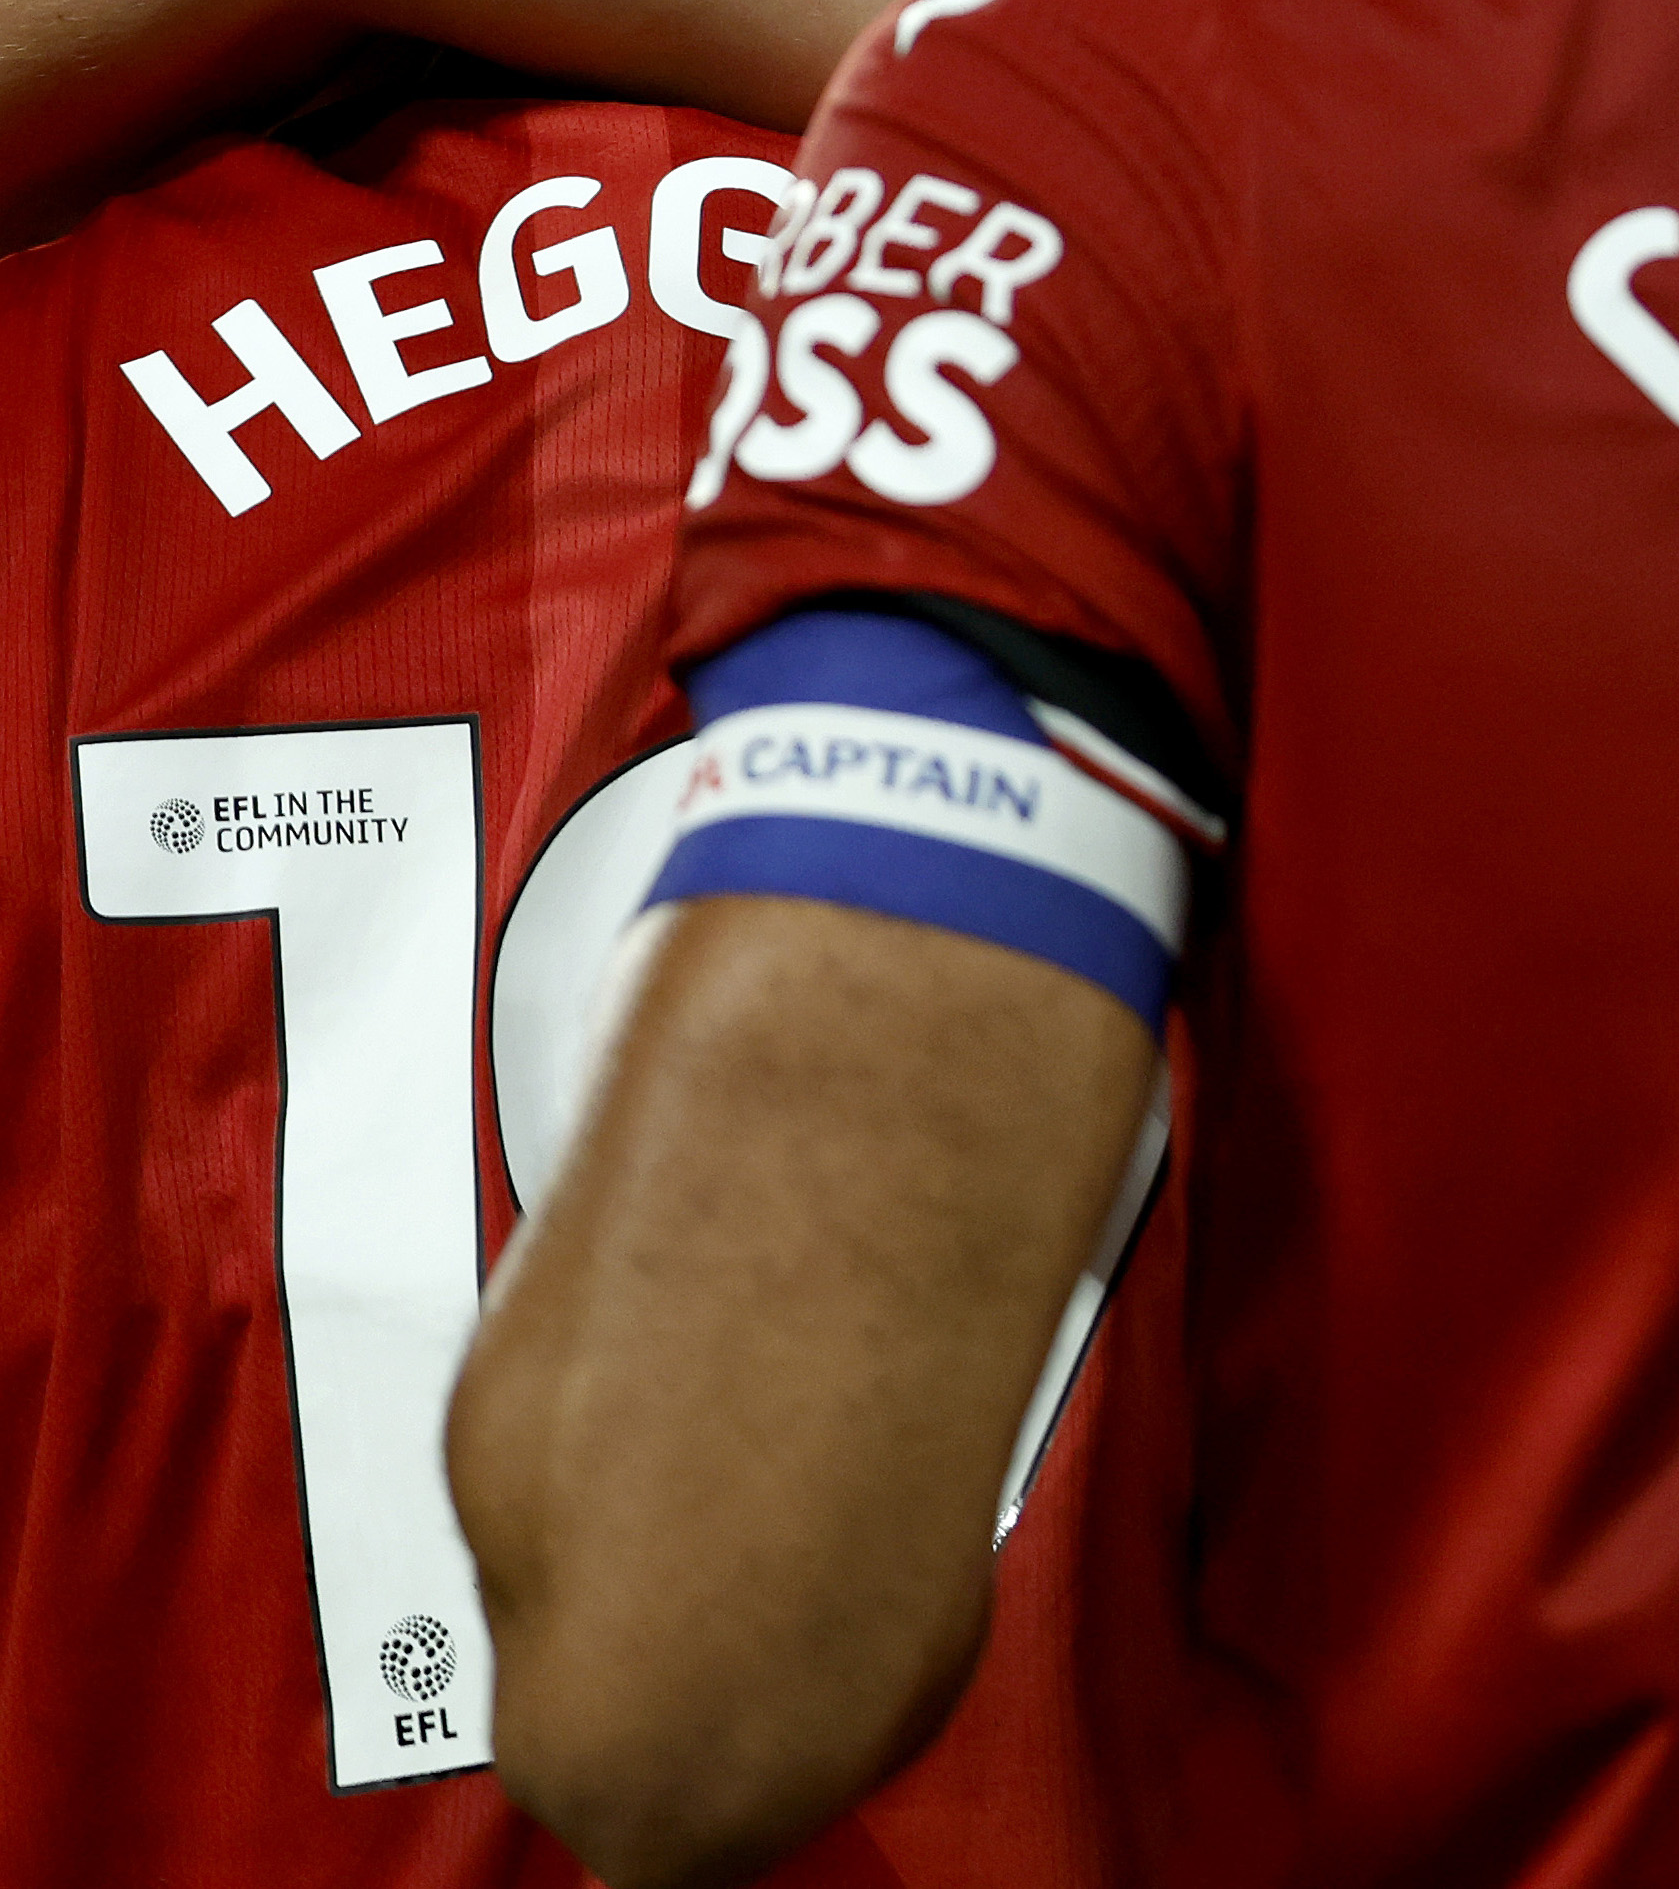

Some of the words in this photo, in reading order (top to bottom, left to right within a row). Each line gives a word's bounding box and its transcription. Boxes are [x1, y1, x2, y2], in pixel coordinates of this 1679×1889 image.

[120, 155, 798, 519] HEGG
[741, 732, 1042, 824] CAPTAIN
[213, 795, 266, 822] EFL
[273, 791, 308, 818] IN
[316, 788, 374, 815] THE
[216, 817, 408, 853] COMMUNITY
[394, 1706, 458, 1747] EFL
